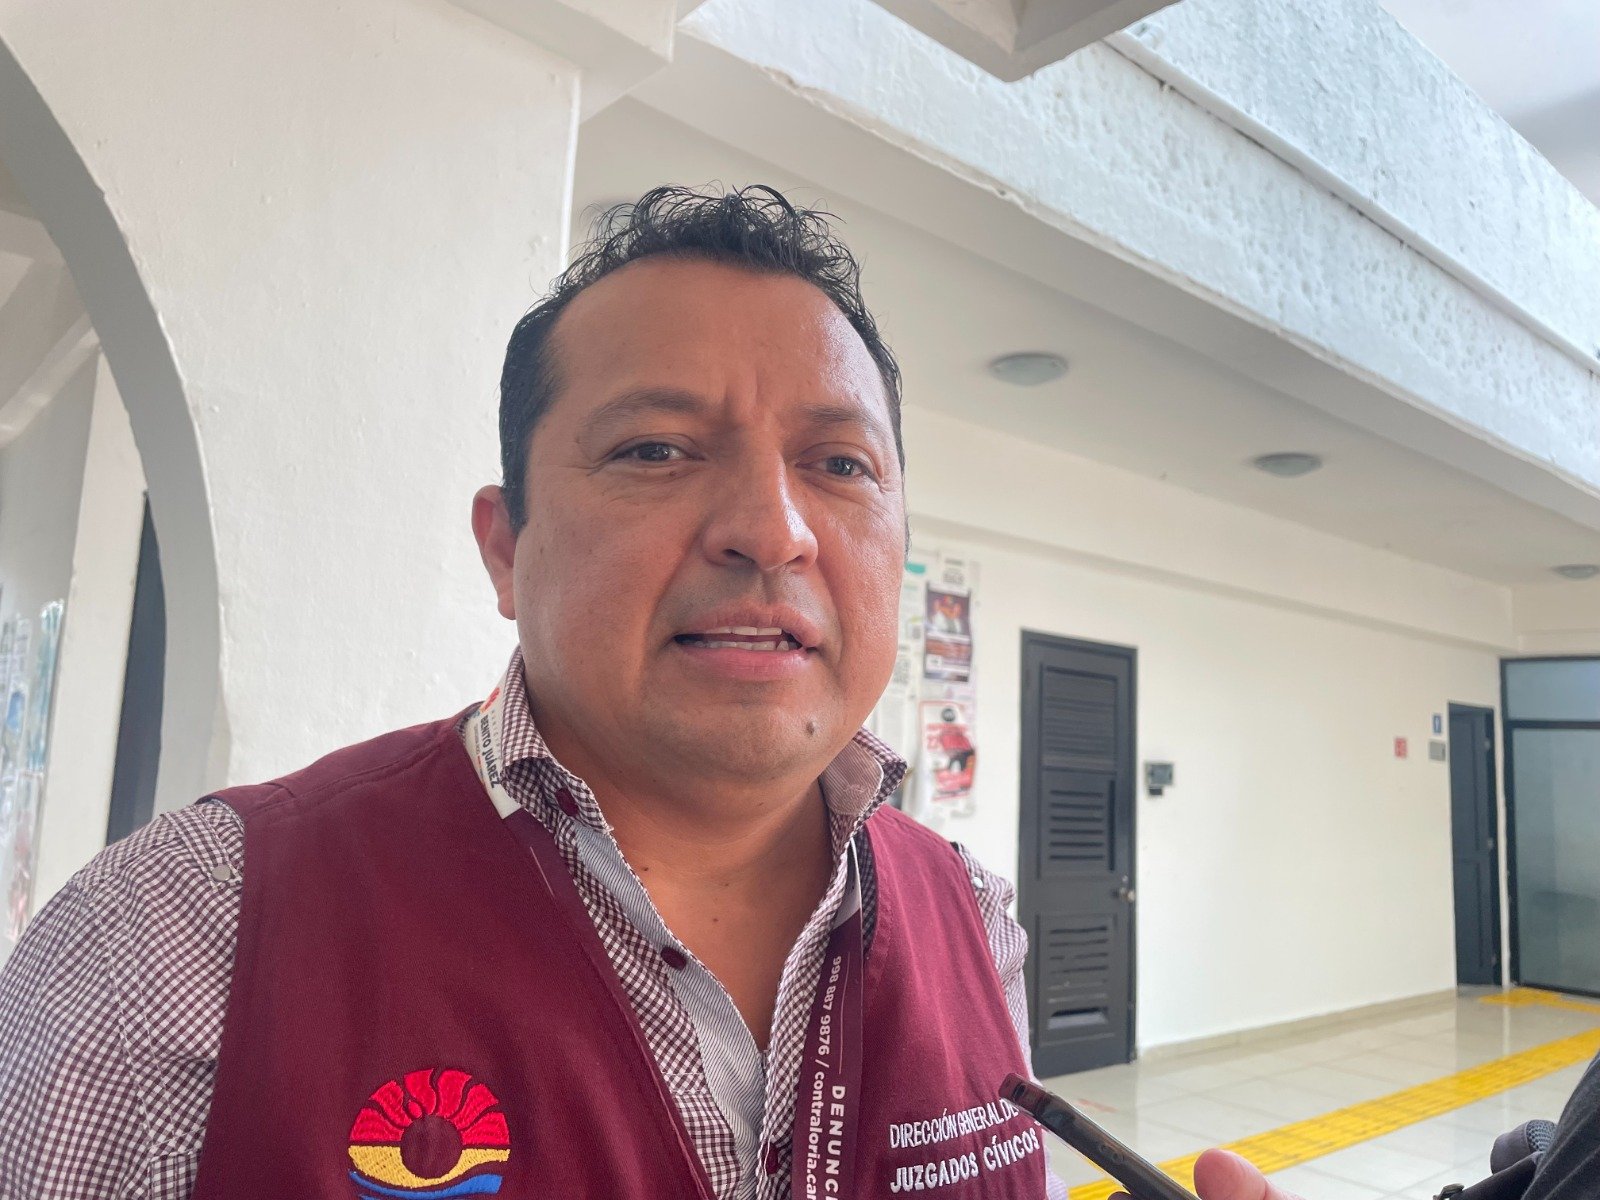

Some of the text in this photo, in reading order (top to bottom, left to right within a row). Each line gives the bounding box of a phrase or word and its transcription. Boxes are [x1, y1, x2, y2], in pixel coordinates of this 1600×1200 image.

[480, 714, 492, 748] BENITO
[481, 748, 501, 789] JUÁREZ
[829, 956, 842, 983] 998
[822, 985, 836, 1011] 887
[818, 1014, 831, 1056] 9876
[889, 1108, 959, 1149] DIRECCIÓN
[957, 1101, 1004, 1136] GENERAL
[889, 1127, 1041, 1193] JUZGADOS CÍVICOS
